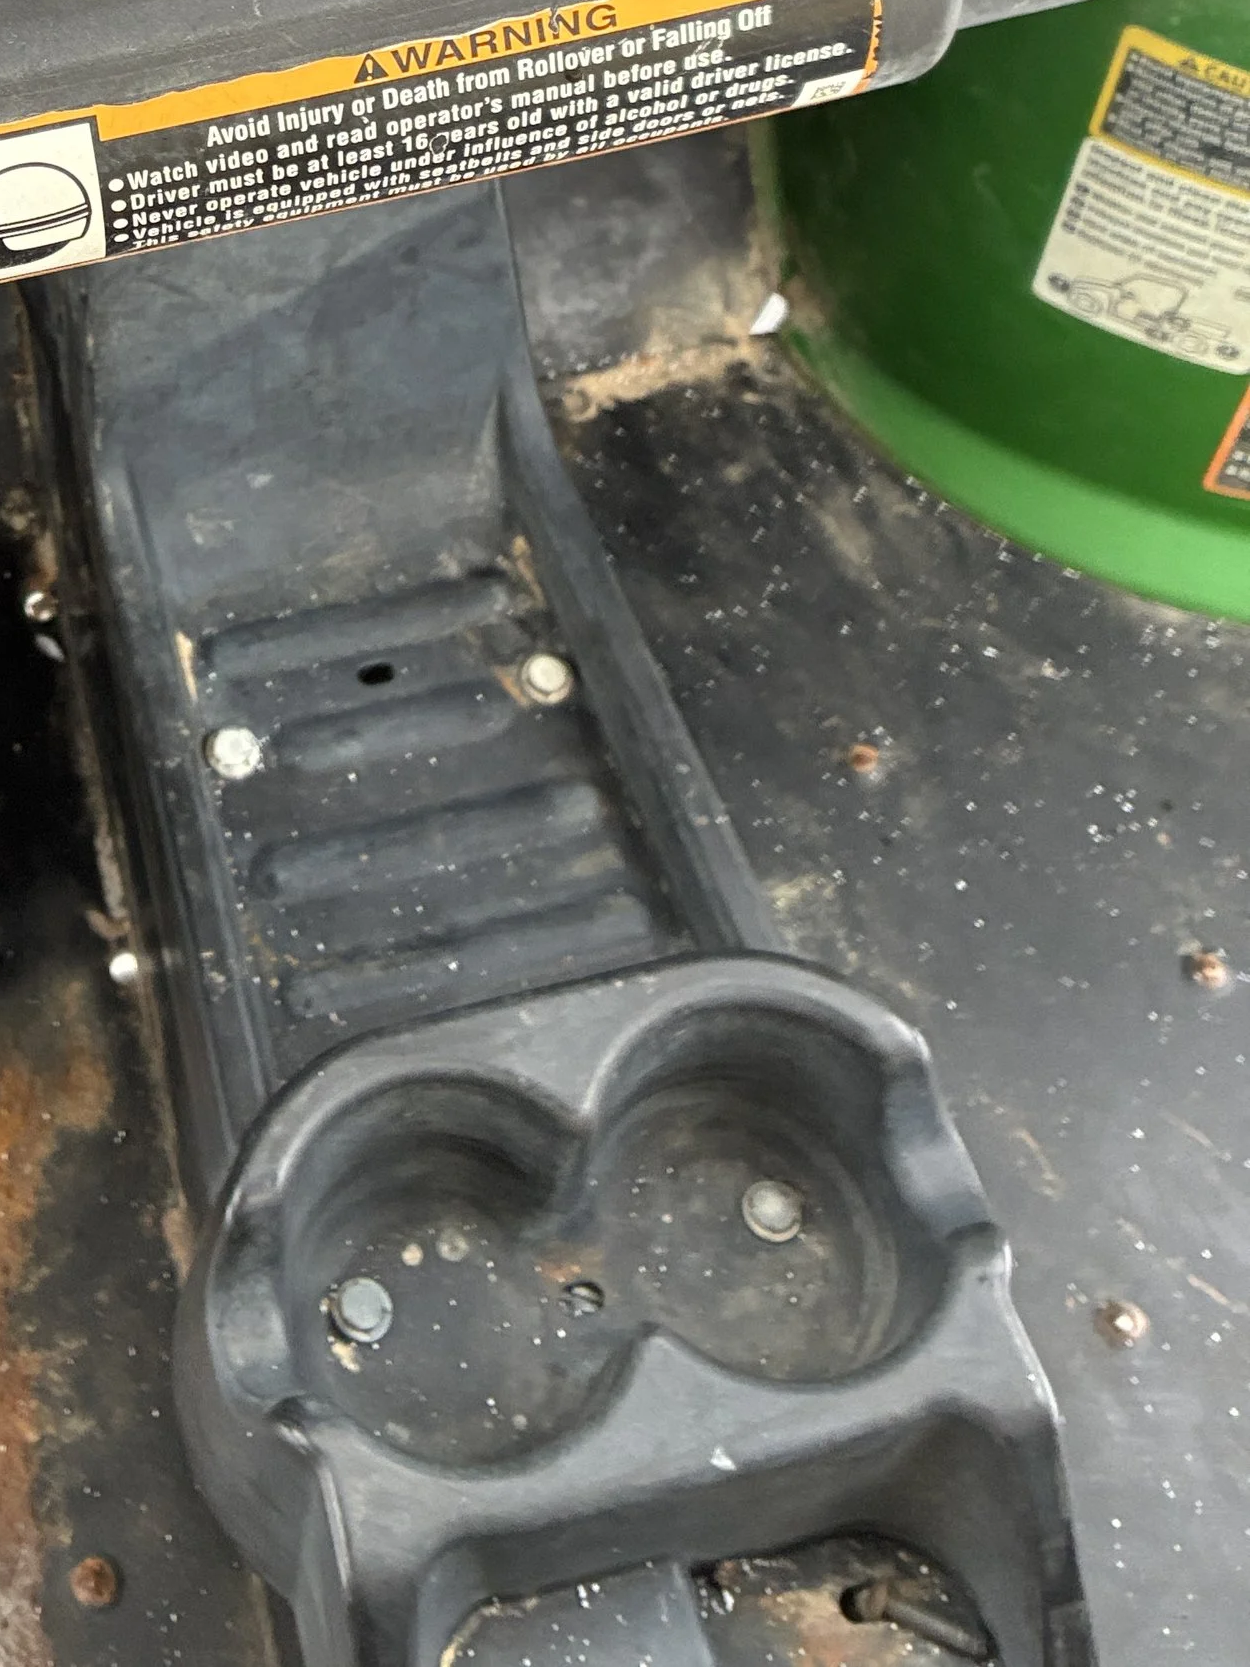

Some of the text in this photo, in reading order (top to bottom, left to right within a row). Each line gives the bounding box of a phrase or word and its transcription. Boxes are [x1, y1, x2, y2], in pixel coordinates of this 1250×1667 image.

[206, 5, 774, 148] Avoid Injury or Death from Rollover or Falling Off
[391, 4, 618, 73] WARNING
[127, 48, 733, 191] Watch video and read operator's manual before use.
[130, 183, 201, 211] Driver
[209, 169, 265, 194] must
[272, 160, 299, 181] be
[306, 154, 331, 173] at
[337, 140, 395, 167] least
[402, 132, 429, 152] 16
[507, 108, 542, 131] old
[550, 96, 598, 121] with
[605, 94, 620, 108] a
[627, 76, 683, 103] valid
[691, 62, 759, 90] driver
[765, 42, 854, 73] license.
[132, 73, 795, 227] Never operate vehicle under influence of alcohol or drugs.
[132, 90, 786, 240] Vehicle is equipped with seatbelts and side doors or nets.
[132, 235, 181, 250] This
[187, 217, 255, 239] safety
[262, 190, 381, 222] equipment
[388, 175, 442, 196] must
[449, 171, 476, 183] be
[483, 157, 536, 176] used
[543, 149, 569, 162] by
